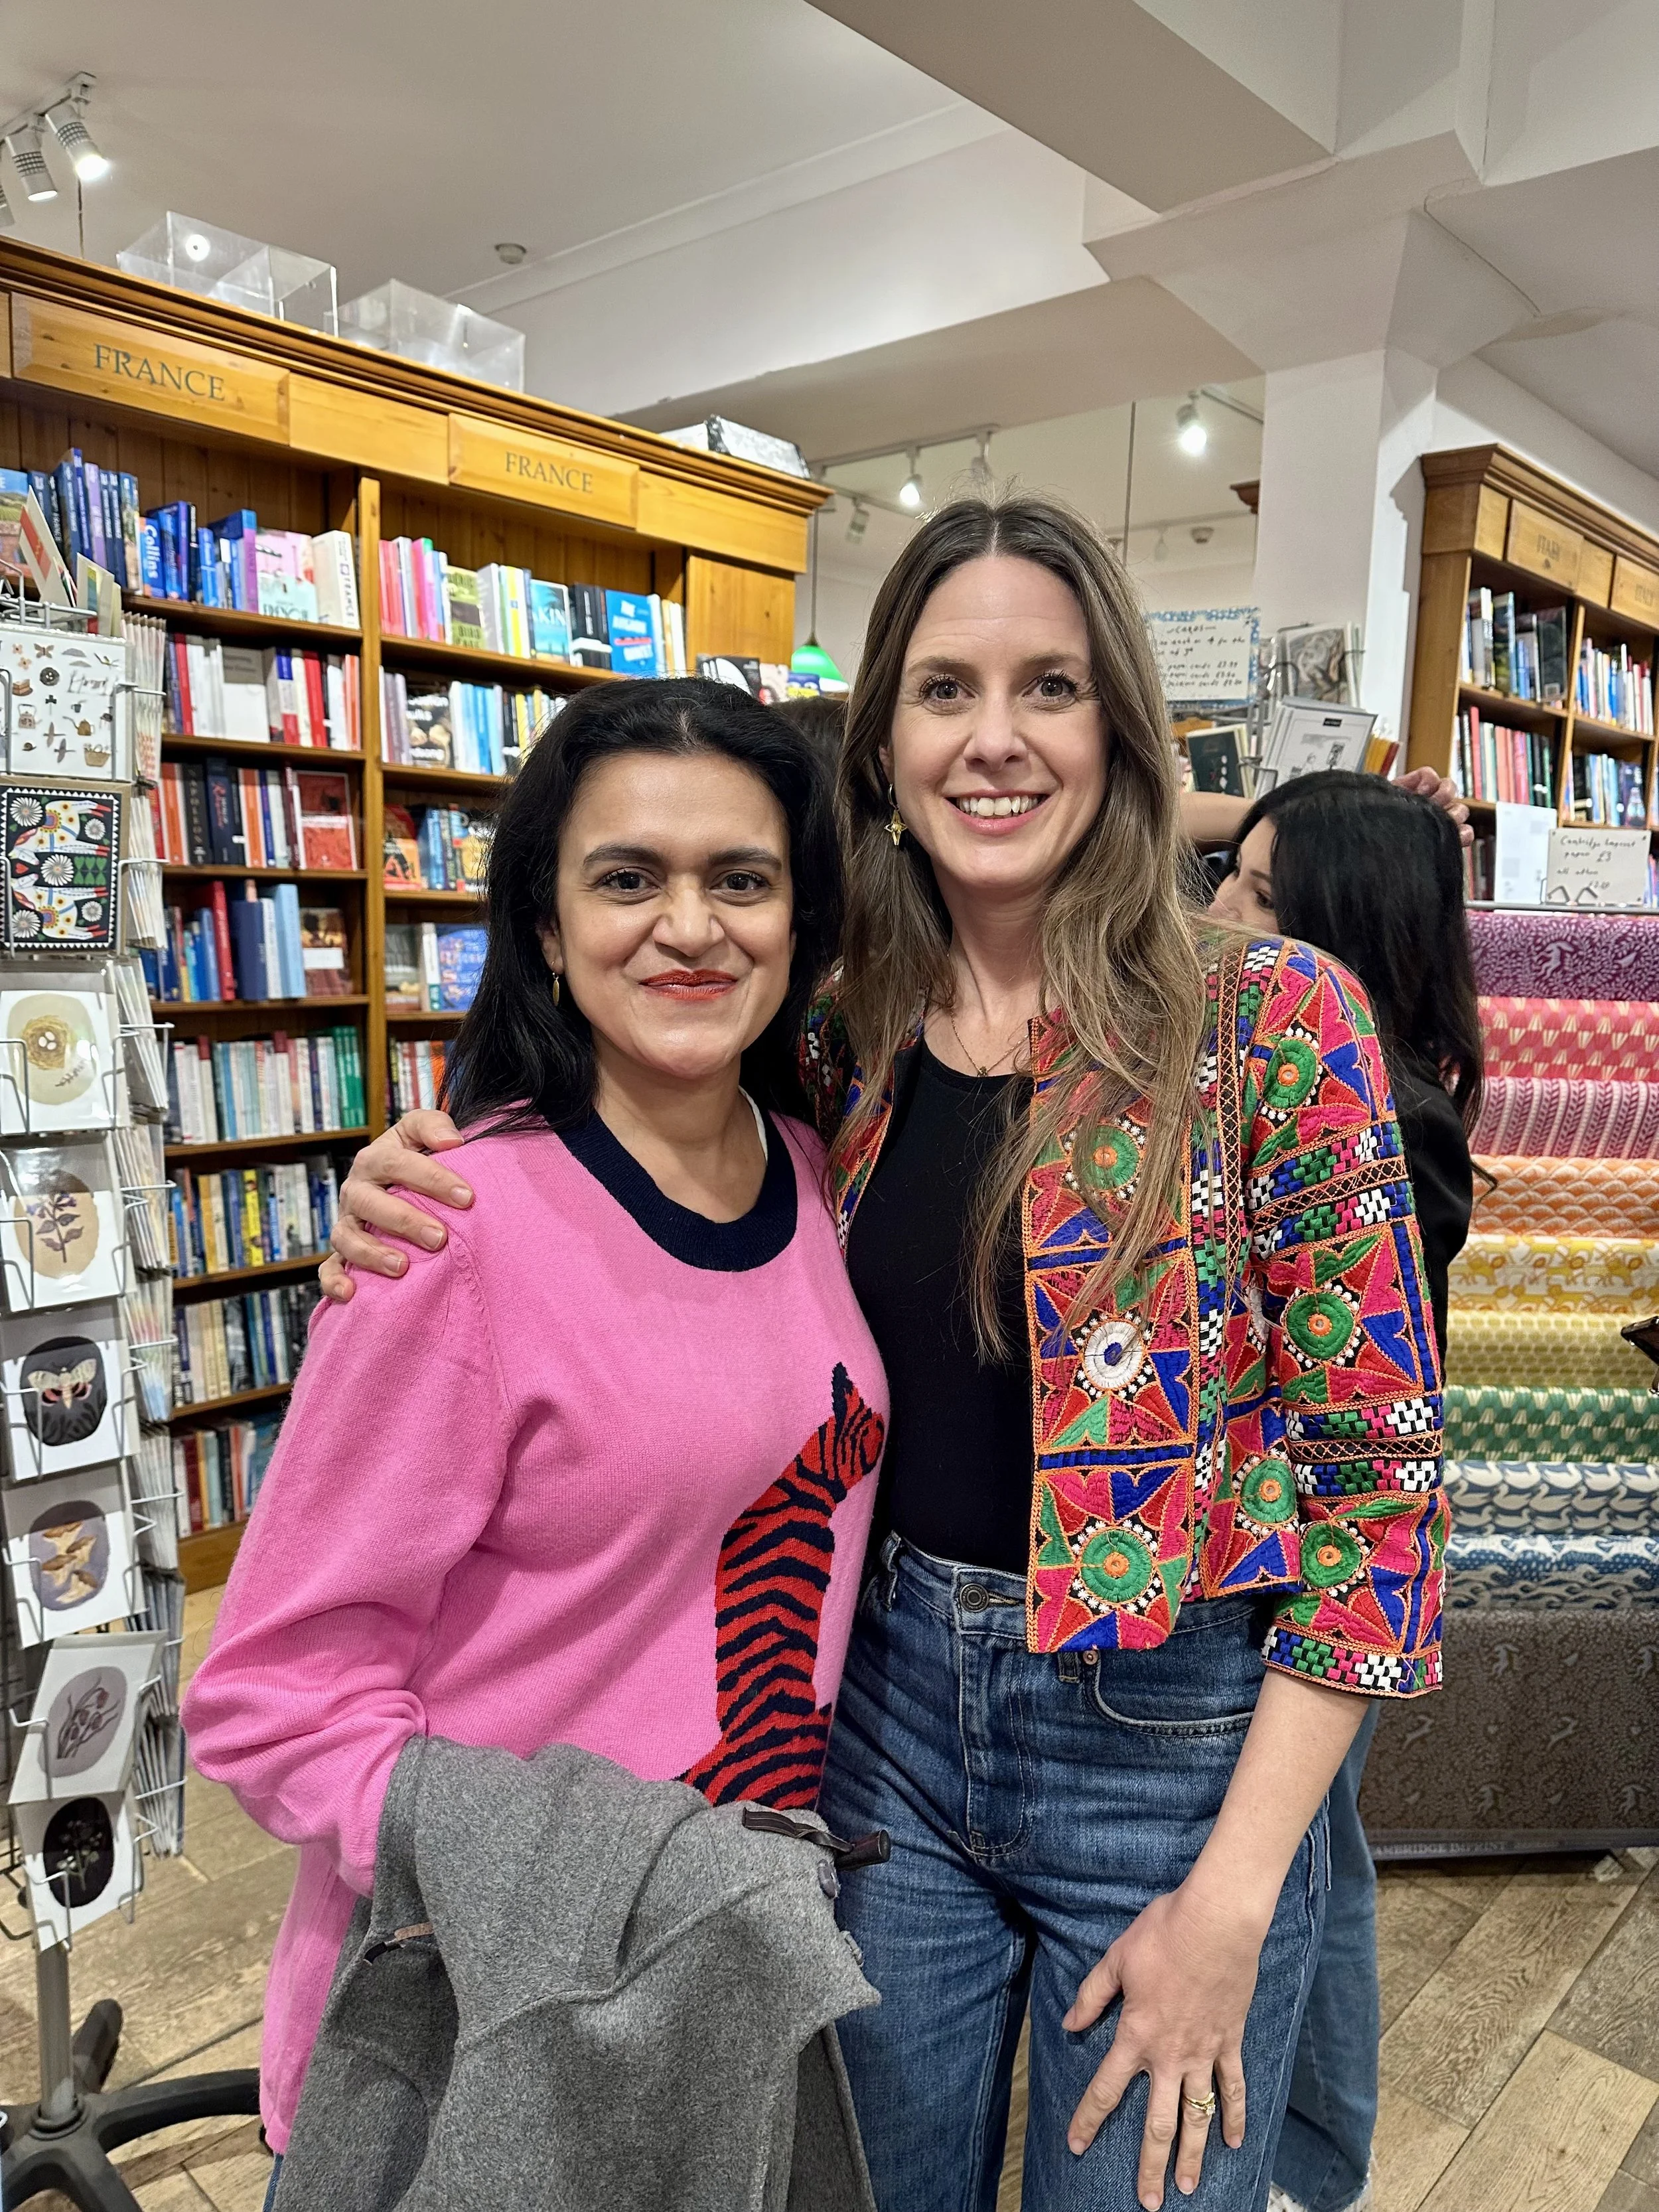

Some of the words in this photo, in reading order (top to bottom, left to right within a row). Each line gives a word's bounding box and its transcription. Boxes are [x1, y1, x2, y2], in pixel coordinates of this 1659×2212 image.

[94, 343, 225, 402] FRANCE
[506, 451, 593, 494] FRANCE
[145, 524, 161, 579] Collins
[342, 576, 355, 617] FRANCE
